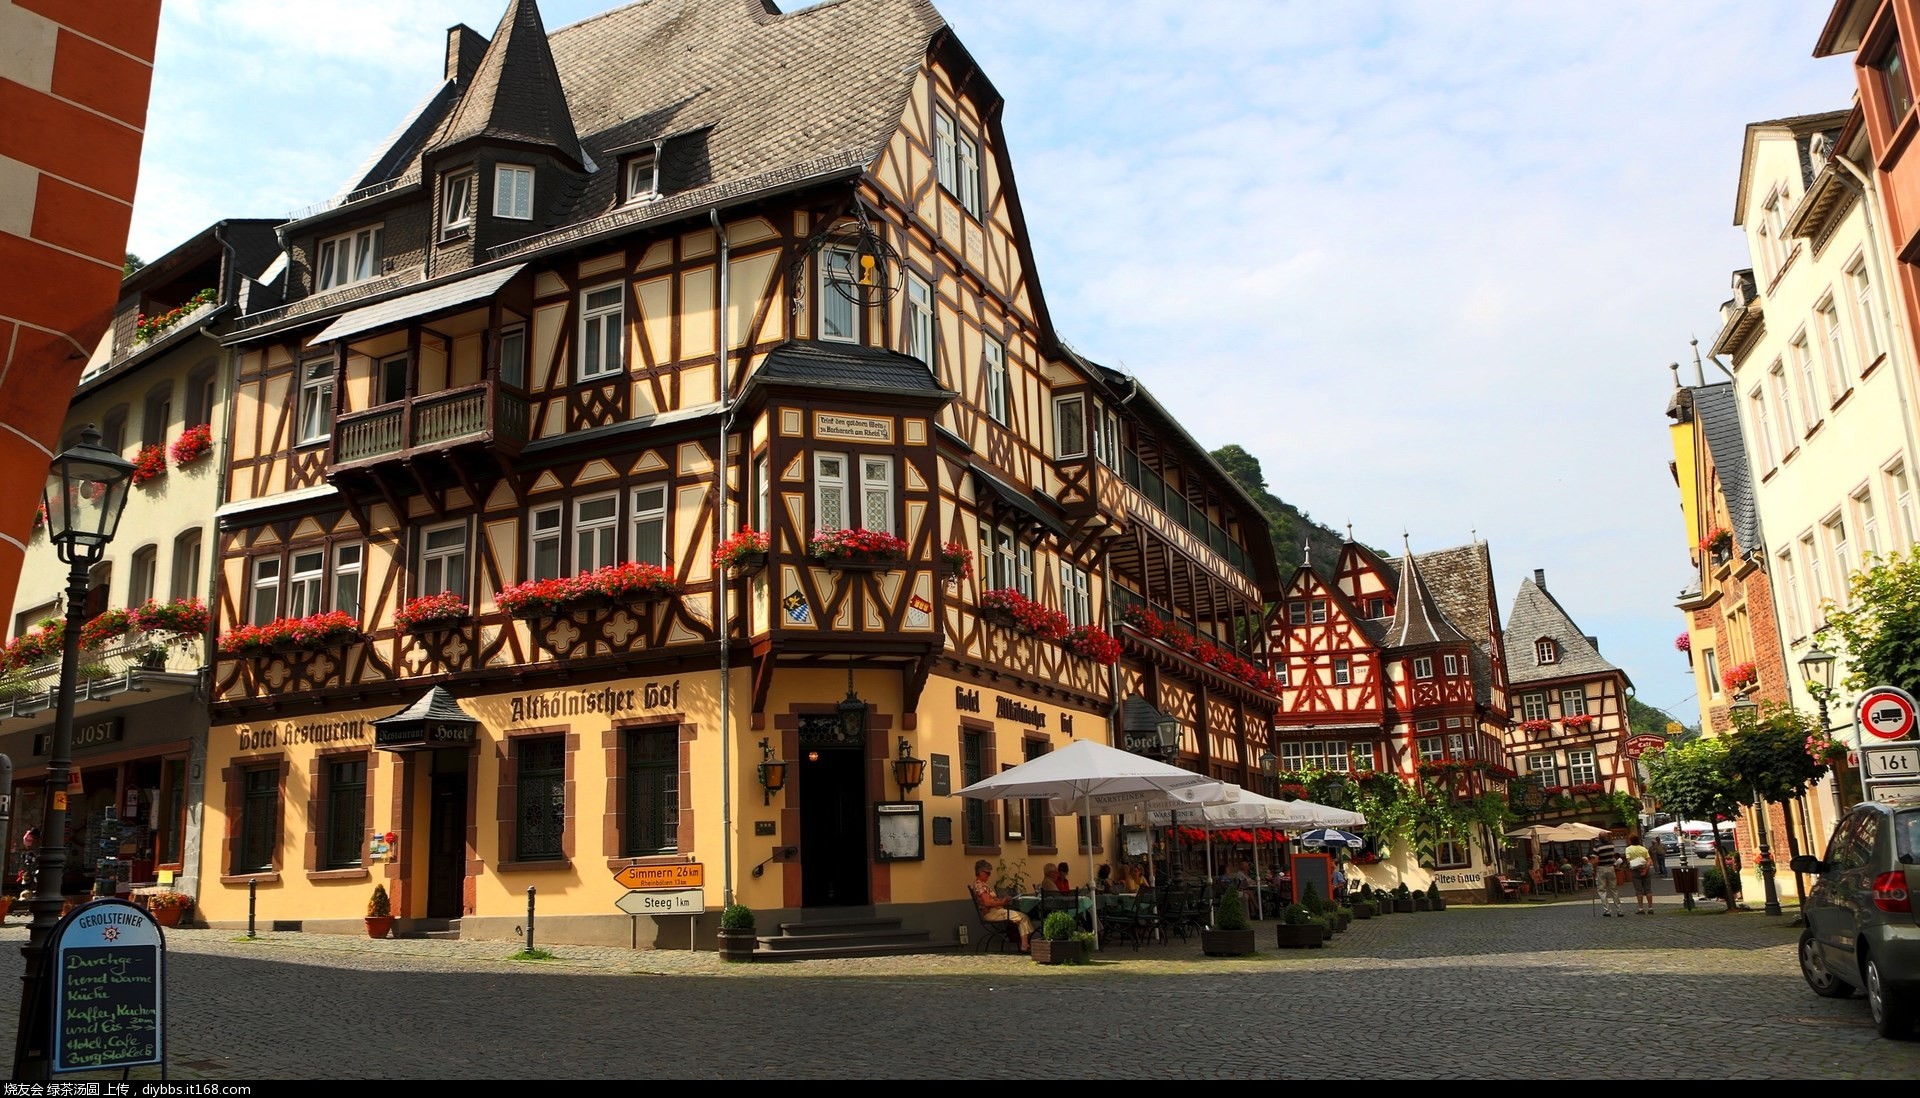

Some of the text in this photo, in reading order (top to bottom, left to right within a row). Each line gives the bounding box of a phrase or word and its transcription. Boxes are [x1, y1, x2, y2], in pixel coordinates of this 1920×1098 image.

[510, 680, 680, 722] Altkölnischer Hof
[955, 685, 980, 713] Hotel
[240, 716, 366, 750] Hotel Restaurant
[379, 726, 469, 742] Restaurant Hotel
[1124, 732, 1157, 751] Hotel
[1094, 792, 1145, 805] WARSTEINER
[629, 868, 673, 879] Simmern
[1434, 873, 1456, 884] Altes
[1457, 872, 1481, 884] Haus
[645, 897, 672, 910] Steeg
[79, 912, 143, 929] GEROLSTEINER
[67, 986, 111, 1001] Küche
[66, 1016, 123, 1035] und Eis
